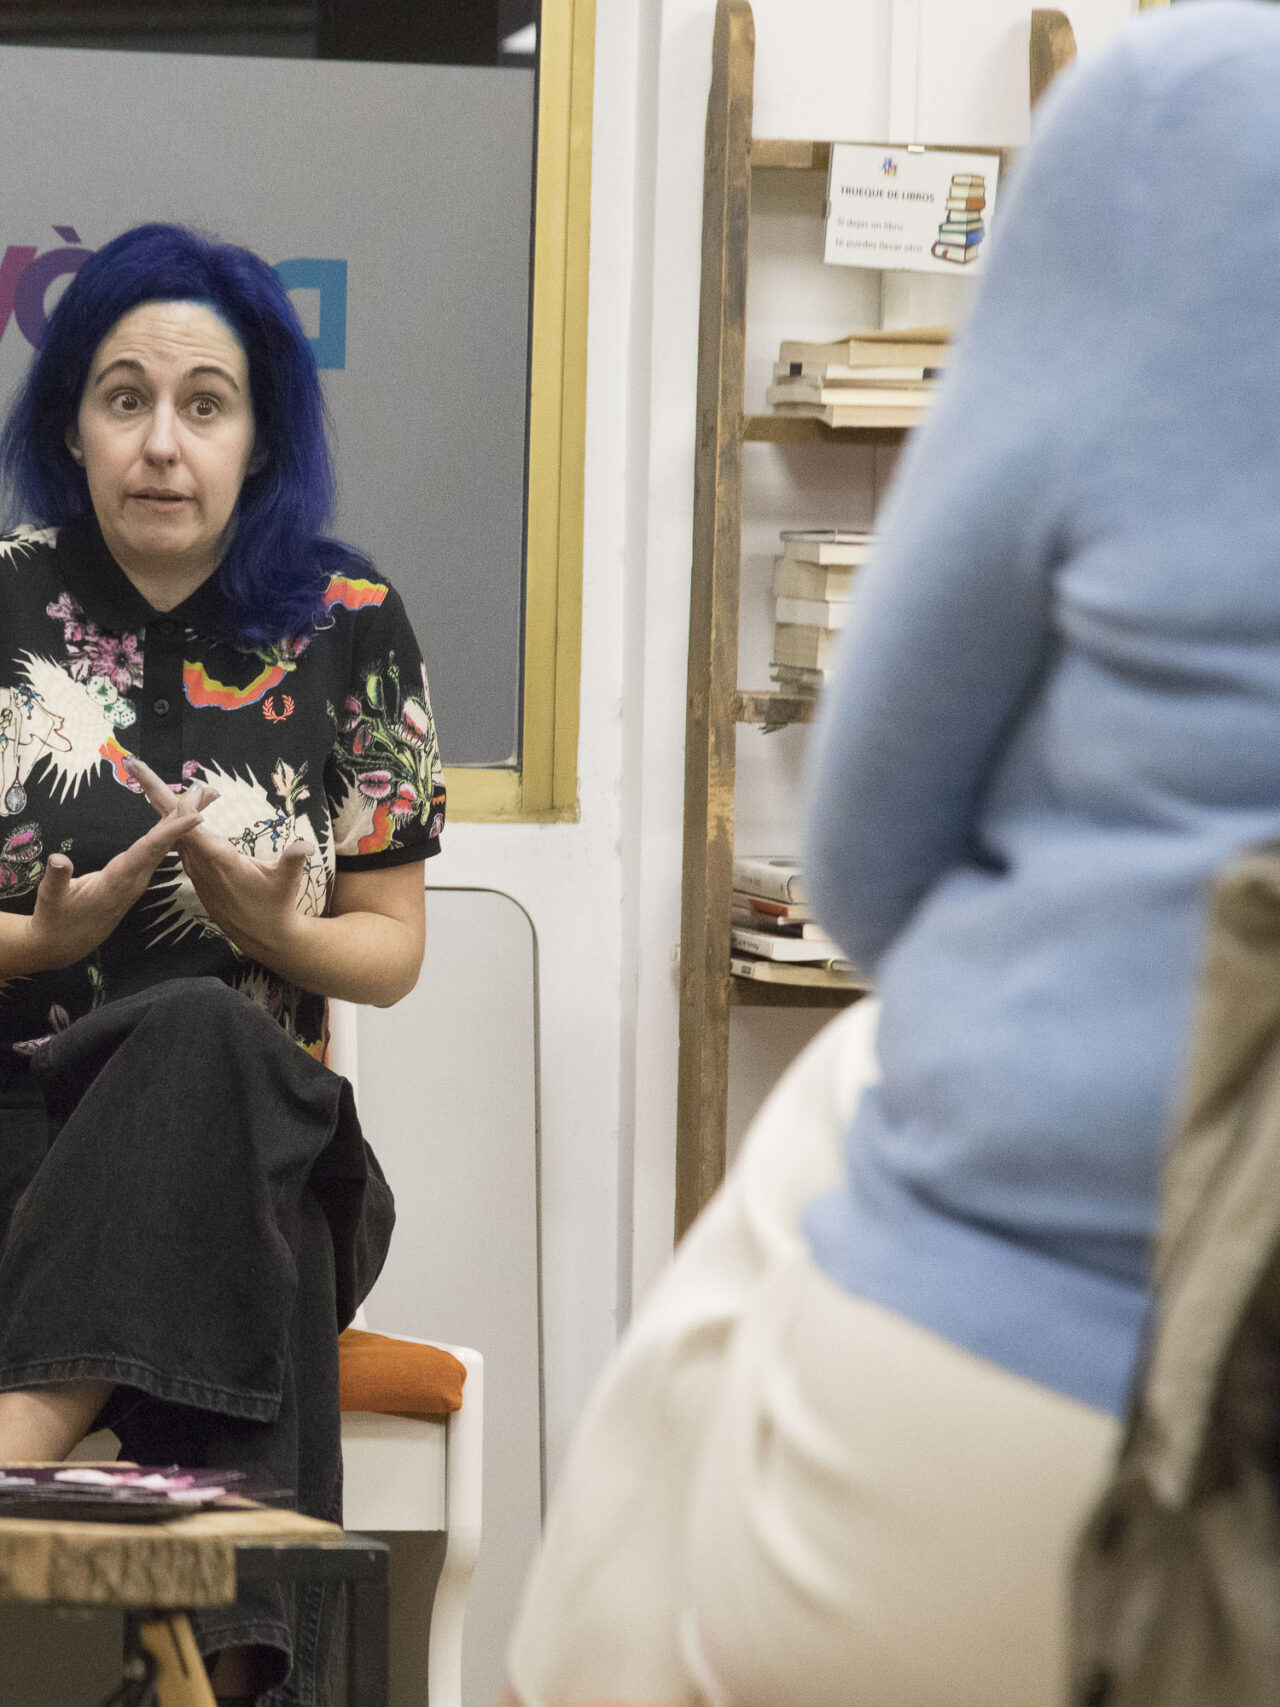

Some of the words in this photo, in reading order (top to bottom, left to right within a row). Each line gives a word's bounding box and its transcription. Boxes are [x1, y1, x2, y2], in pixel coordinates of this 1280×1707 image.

[841, 185, 884, 199] TRUEQUE
[887, 189, 898, 199] DE
[902, 191, 935, 203] LIBROS
